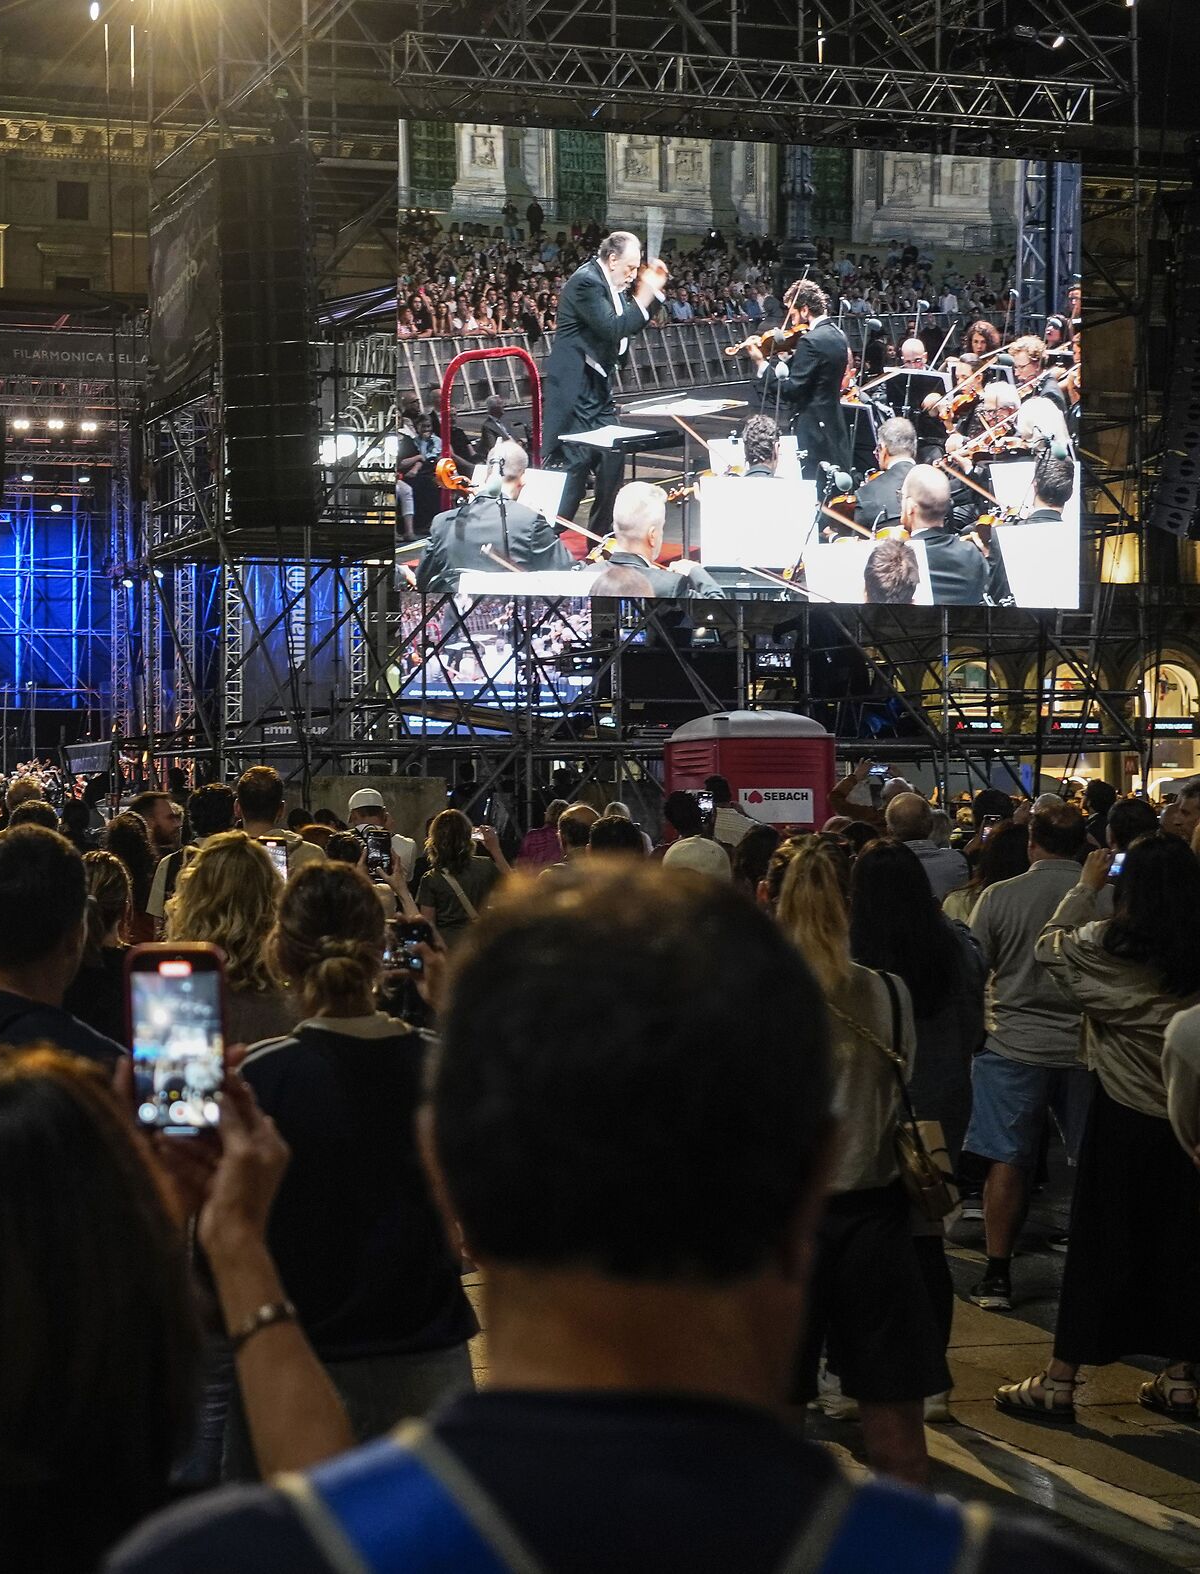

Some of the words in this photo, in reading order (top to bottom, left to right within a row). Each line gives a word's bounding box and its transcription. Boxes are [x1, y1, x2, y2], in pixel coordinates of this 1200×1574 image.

[13, 349, 104, 362] FILARMONICA
[743, 792, 748, 801] I
[763, 792, 809, 801] SEBACH
